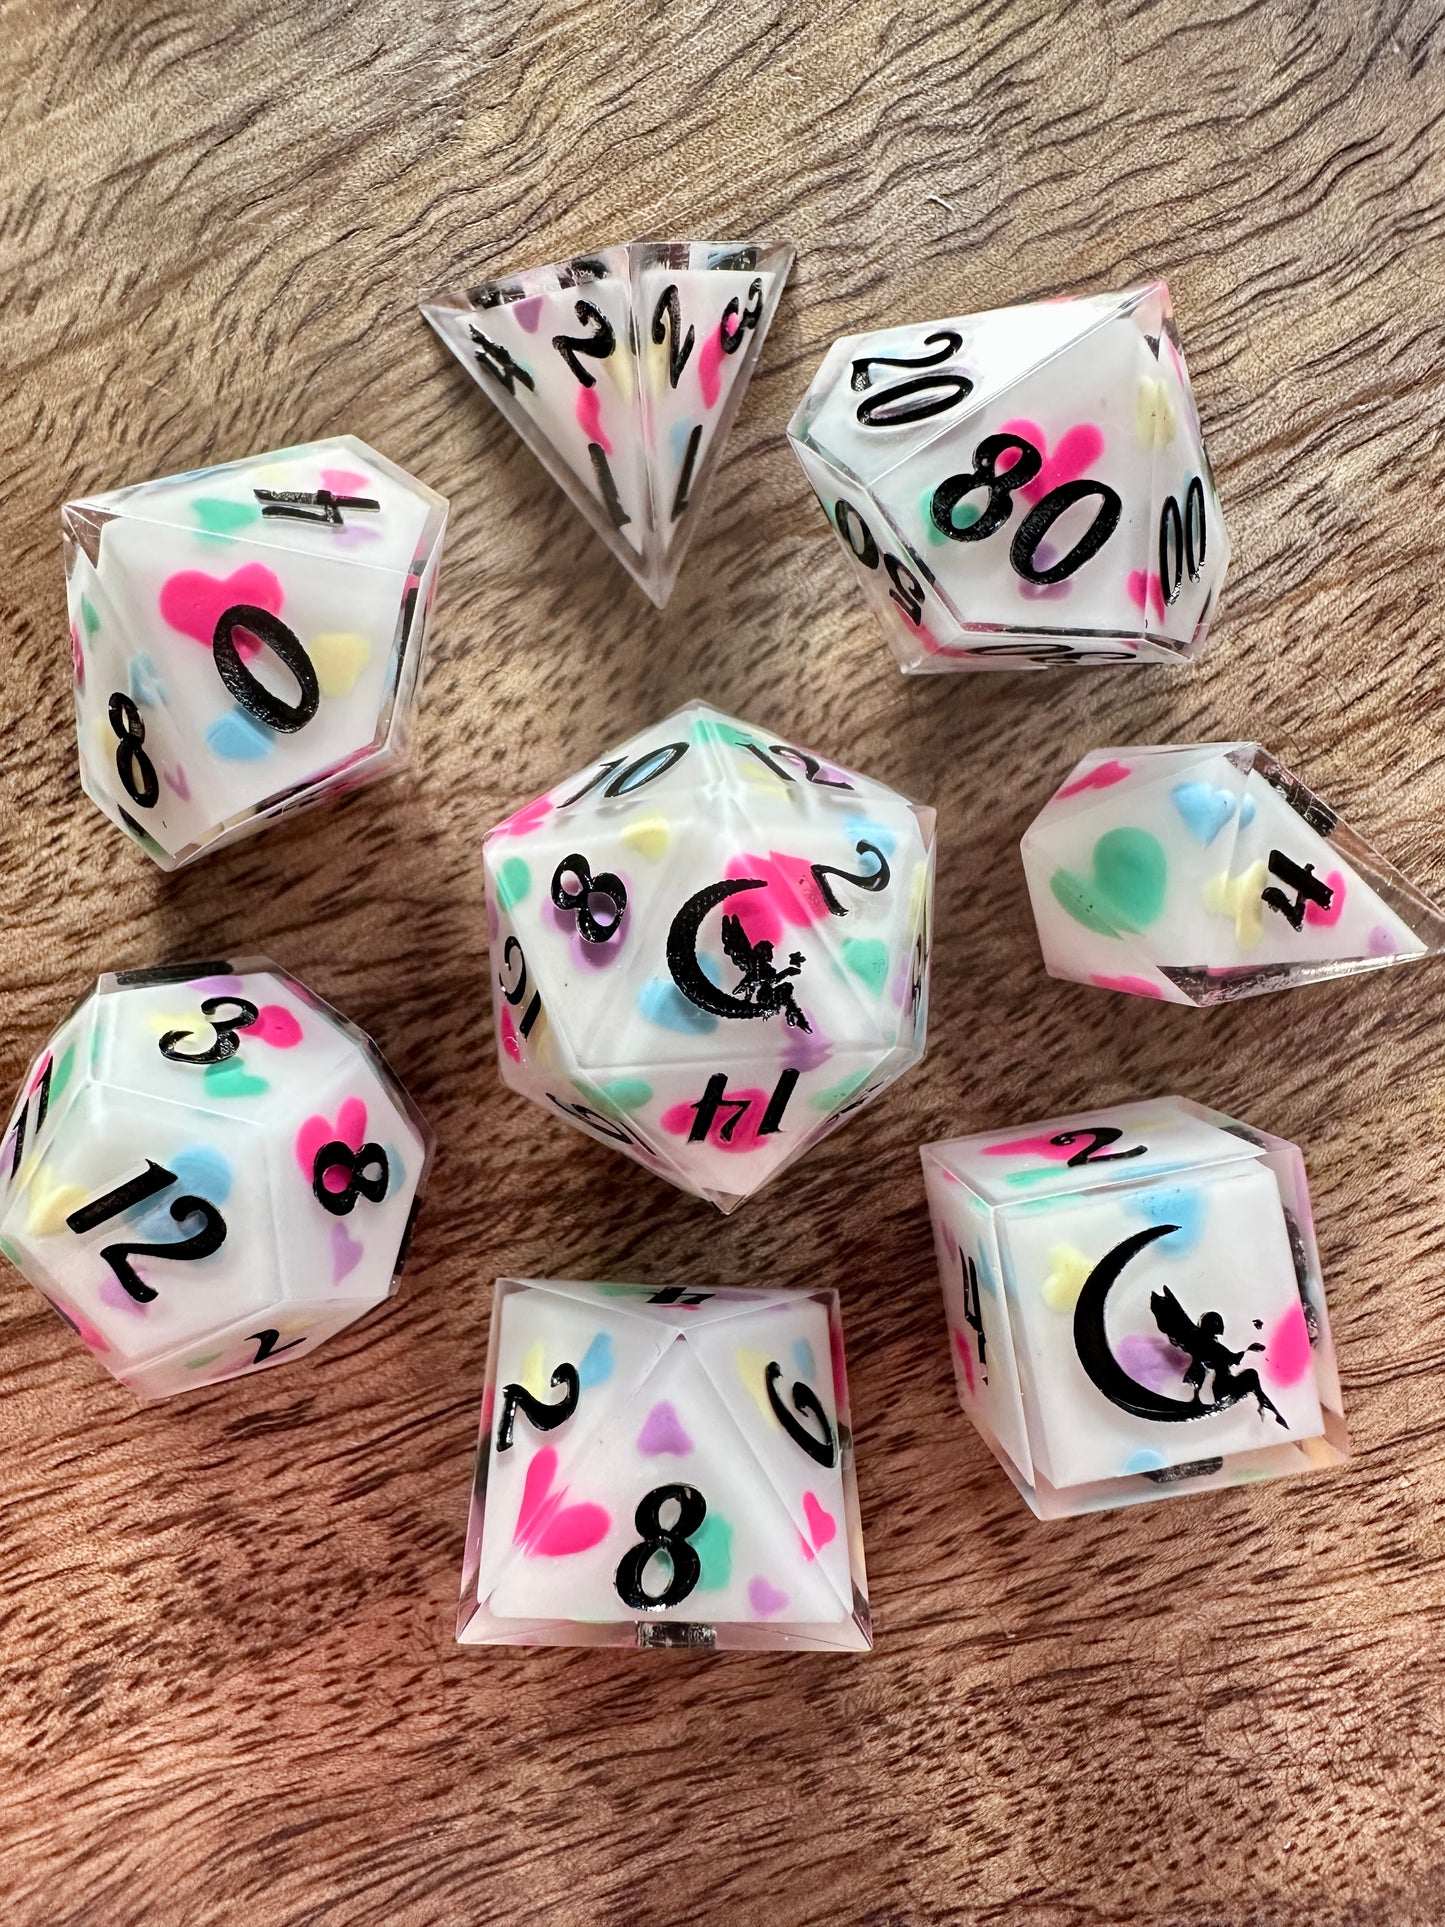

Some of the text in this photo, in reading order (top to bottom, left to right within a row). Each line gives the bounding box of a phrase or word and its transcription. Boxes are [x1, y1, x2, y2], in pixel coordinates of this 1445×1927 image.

[552, 299, 617, 389] 2
[652, 284, 696, 389] 2
[721, 277, 763, 355] 3
[851, 331, 974, 426] 20
[671, 424, 703, 523] 1
[930, 433, 1123, 585] 80
[212, 605, 320, 734] 0
[108, 692, 159, 809] 8
[556, 741, 690, 809] 10
[735, 742, 855, 791] 12
[551, 853, 628, 944] 8
[810, 839, 891, 917] 2
[1261, 849, 1335, 932] 4
[158, 997, 260, 1064] 3
[313, 1141, 389, 1216] 8
[1050, 1127, 1148, 1167] 2
[66, 1158, 228, 1304] 12
[245, 1329, 307, 1364] 2
[496, 1362, 580, 1453] 2
[613, 1482, 707, 1612] 8
